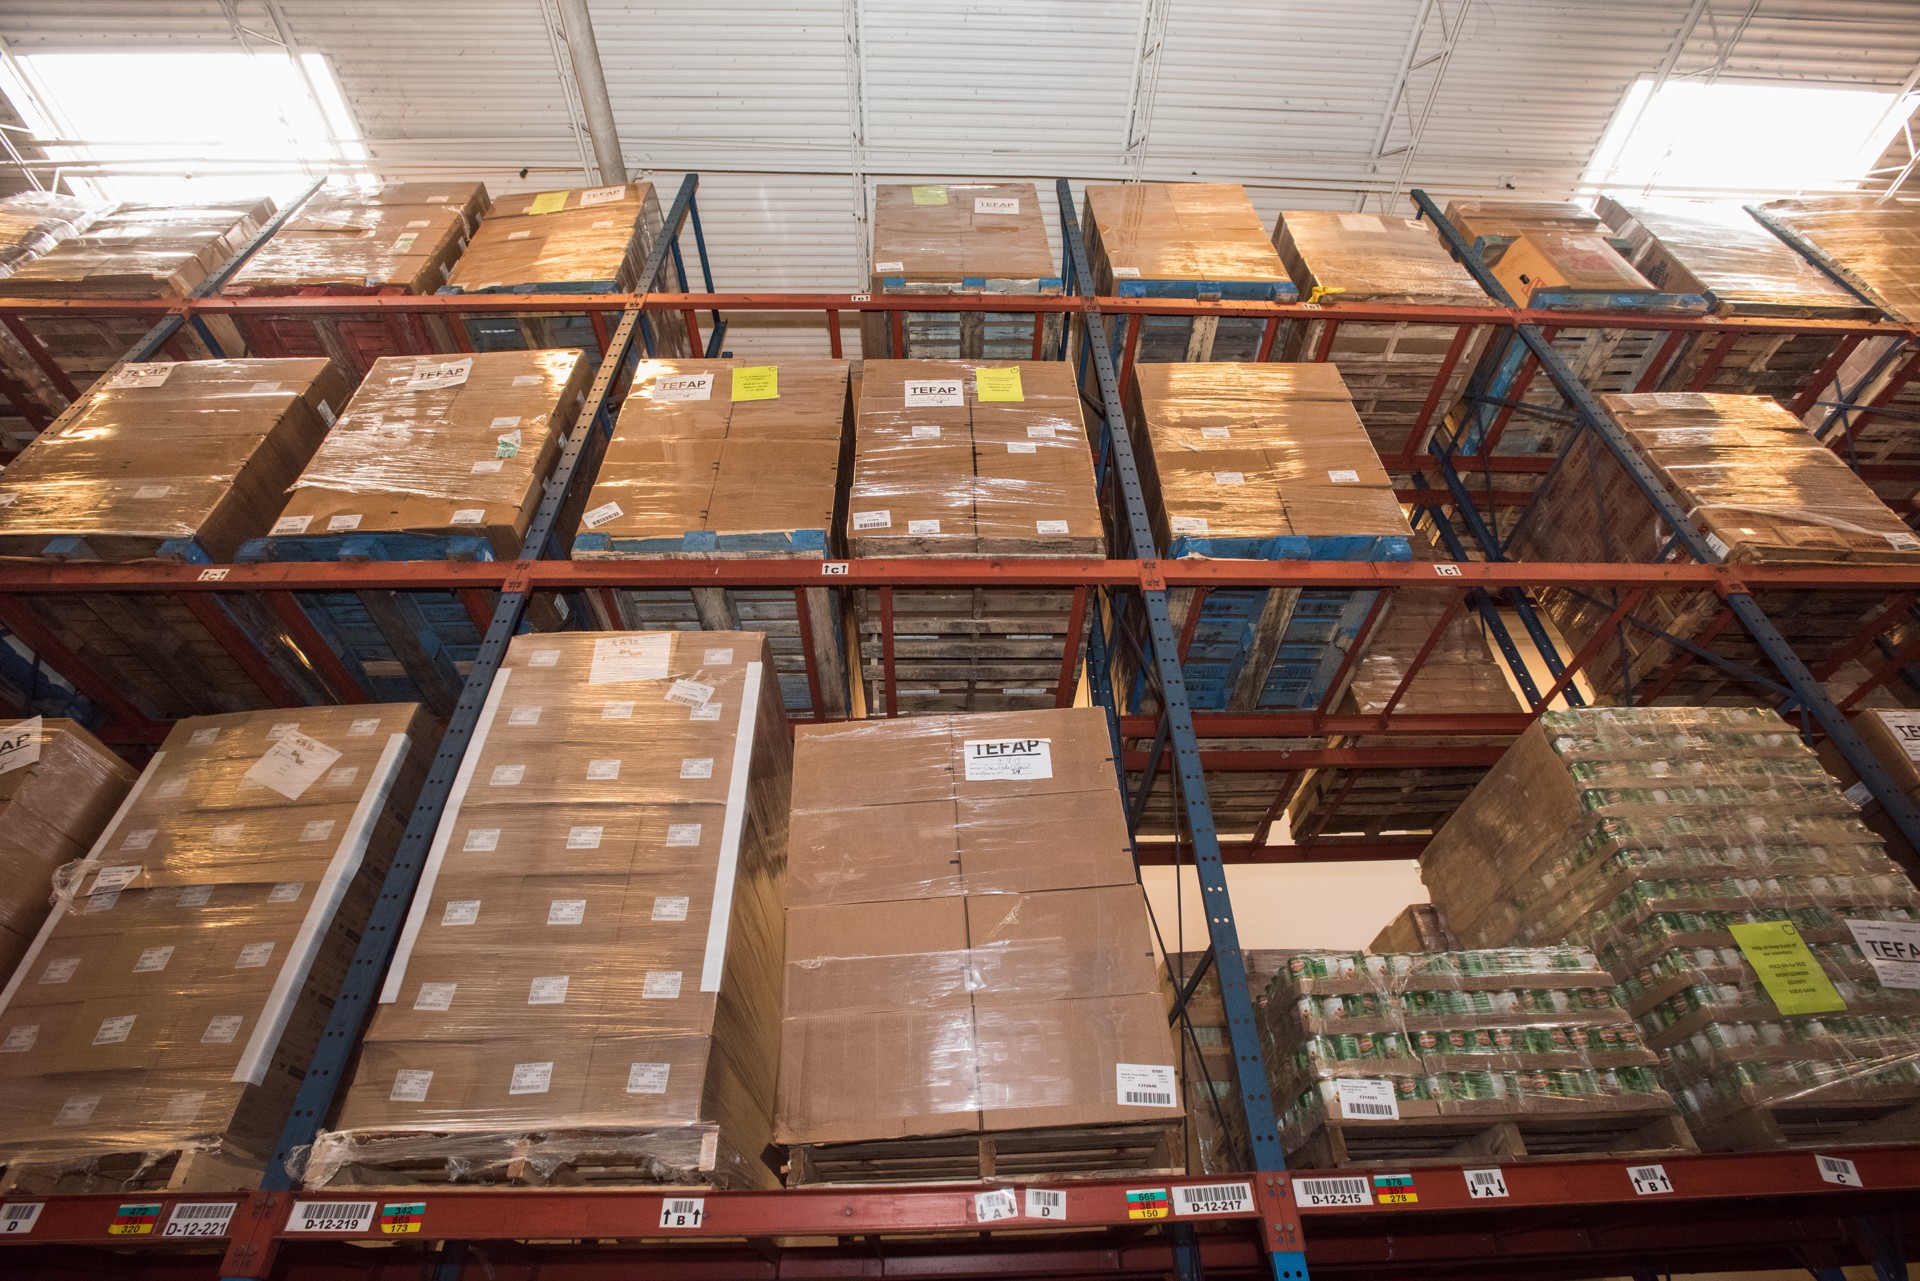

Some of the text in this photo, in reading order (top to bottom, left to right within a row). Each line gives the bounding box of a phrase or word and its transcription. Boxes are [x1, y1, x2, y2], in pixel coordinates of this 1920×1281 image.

[125, 367, 167, 377] TEAP
[420, 368, 464, 379] TEFAP
[661, 380, 706, 389] TEFAP
[911, 386, 957, 394] TEFAP
[1894, 725, 1920, 737] TE
[1385, 1178, 1402, 1186] 878
[1836, 1173, 1847, 1184] C
[1485, 1186, 1494, 1197] A
[1648, 1182, 1659, 1192] B
[1138, 1193, 1156, 1201] 665
[1311, 1195, 1361, 1205] D-12-215
[1390, 1195, 1407, 1203] 278
[129, 1207, 148, 1215] 472
[394, 1206, 413, 1215] 342
[1192, 1201, 1242, 1212] D-12-217
[993, 1208, 1002, 1219] A
[1041, 1207, 1050, 1217] D
[1141, 1210, 1158, 1218] 150
[305, 1219, 358, 1230] D-12-219
[676, 1215, 686, 1225] B
[7, 1221, 18, 1231] D
[121, 1225, 140, 1233] 320
[165, 1222, 227, 1235] D-12-221
